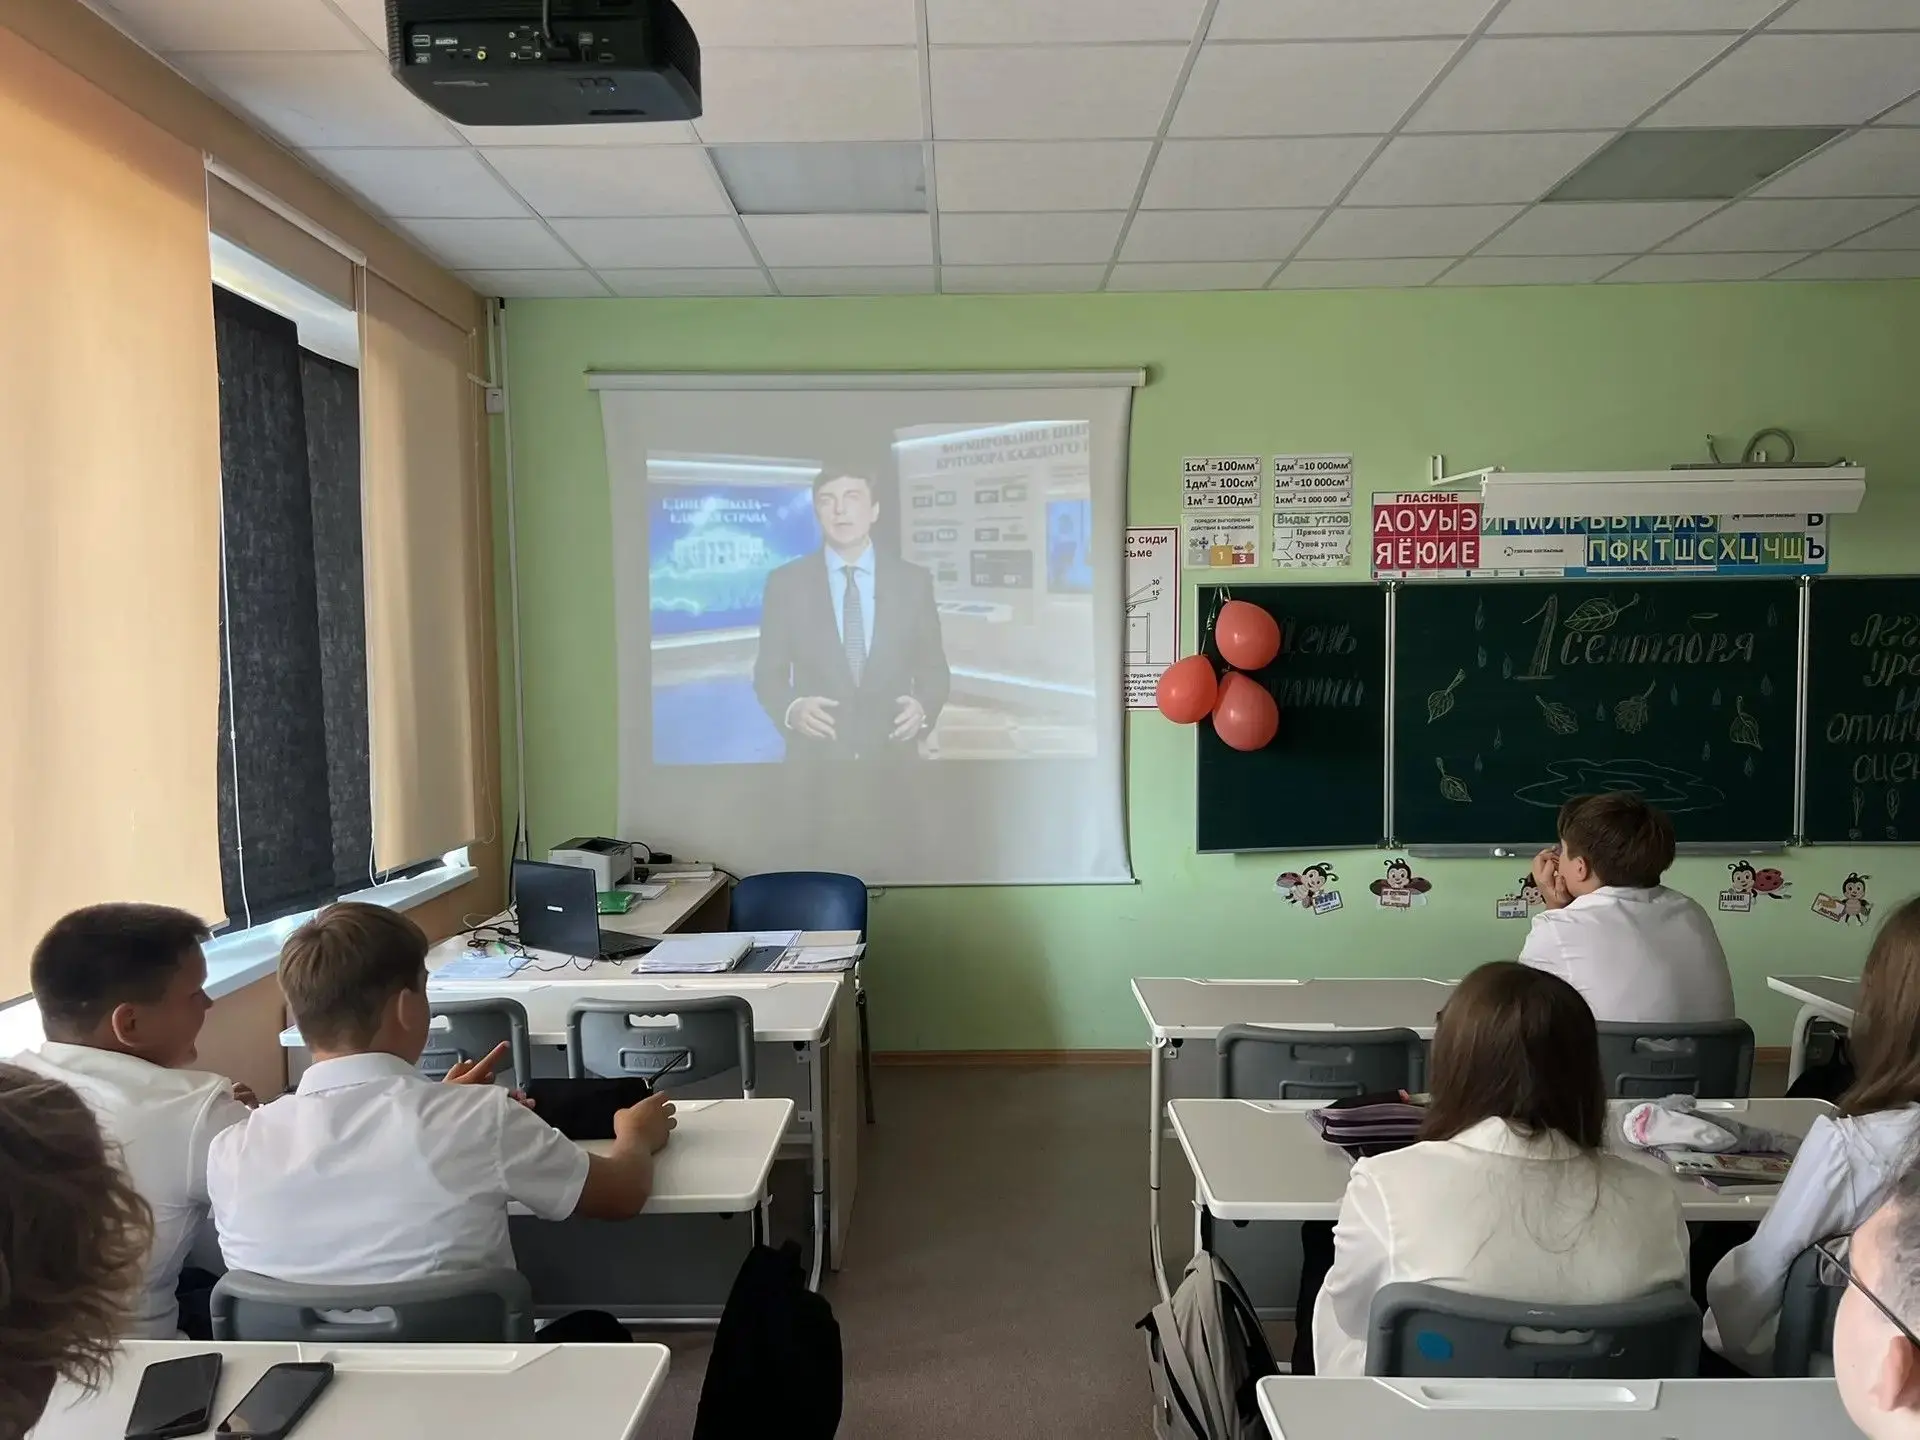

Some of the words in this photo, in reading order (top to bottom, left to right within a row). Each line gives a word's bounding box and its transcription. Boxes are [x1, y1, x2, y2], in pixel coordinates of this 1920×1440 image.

[1396, 493, 1458, 503] ГЛАСНЫЕ
[1277, 513, 1310, 525] Виды
[1315, 515, 1349, 527] углов
[1328, 529, 1345, 537] угол
[1138, 536, 1168, 546] сиди
[1320, 541, 1338, 549] угол
[1239, 554, 1246, 563] 3
[1327, 553, 1344, 561] угол
